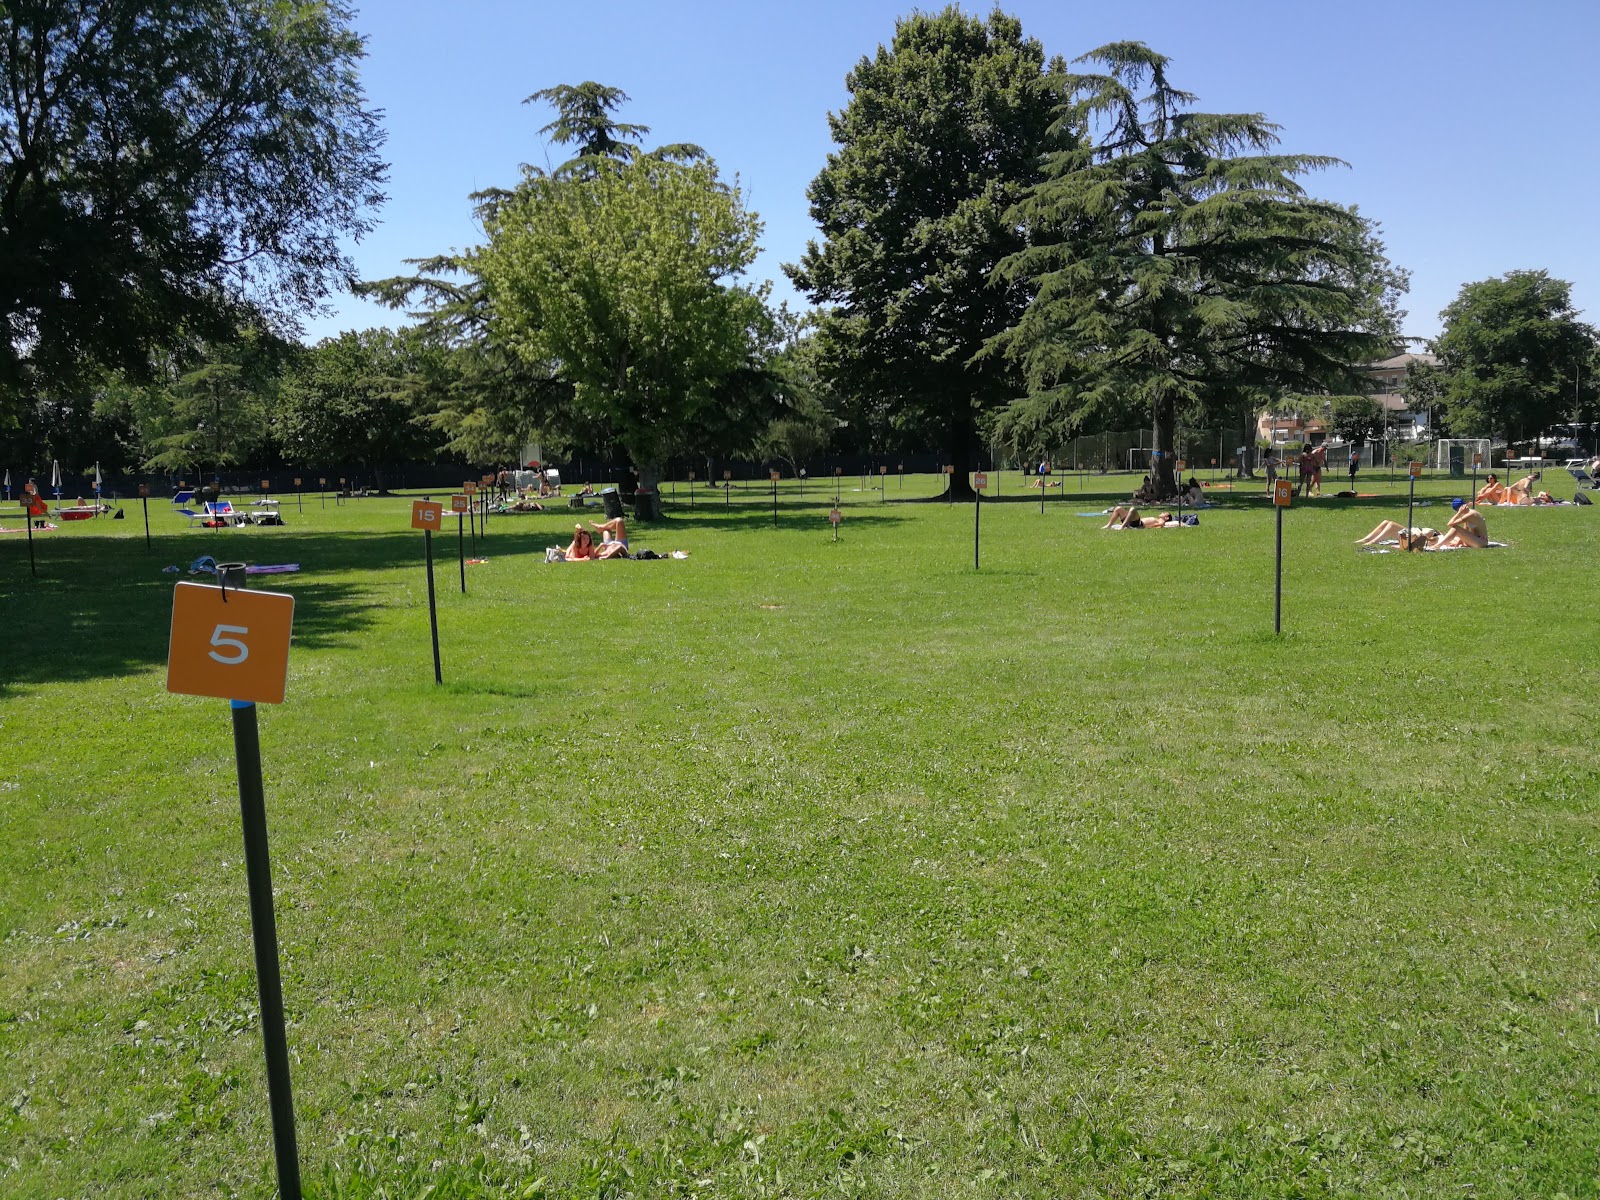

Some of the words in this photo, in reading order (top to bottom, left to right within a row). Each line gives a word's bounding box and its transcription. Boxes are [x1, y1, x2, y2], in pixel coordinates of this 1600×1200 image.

[1279, 488, 1288, 497] 16
[454, 500, 465, 508] 25
[419, 509, 434, 521] 15
[208, 624, 249, 665] 5
